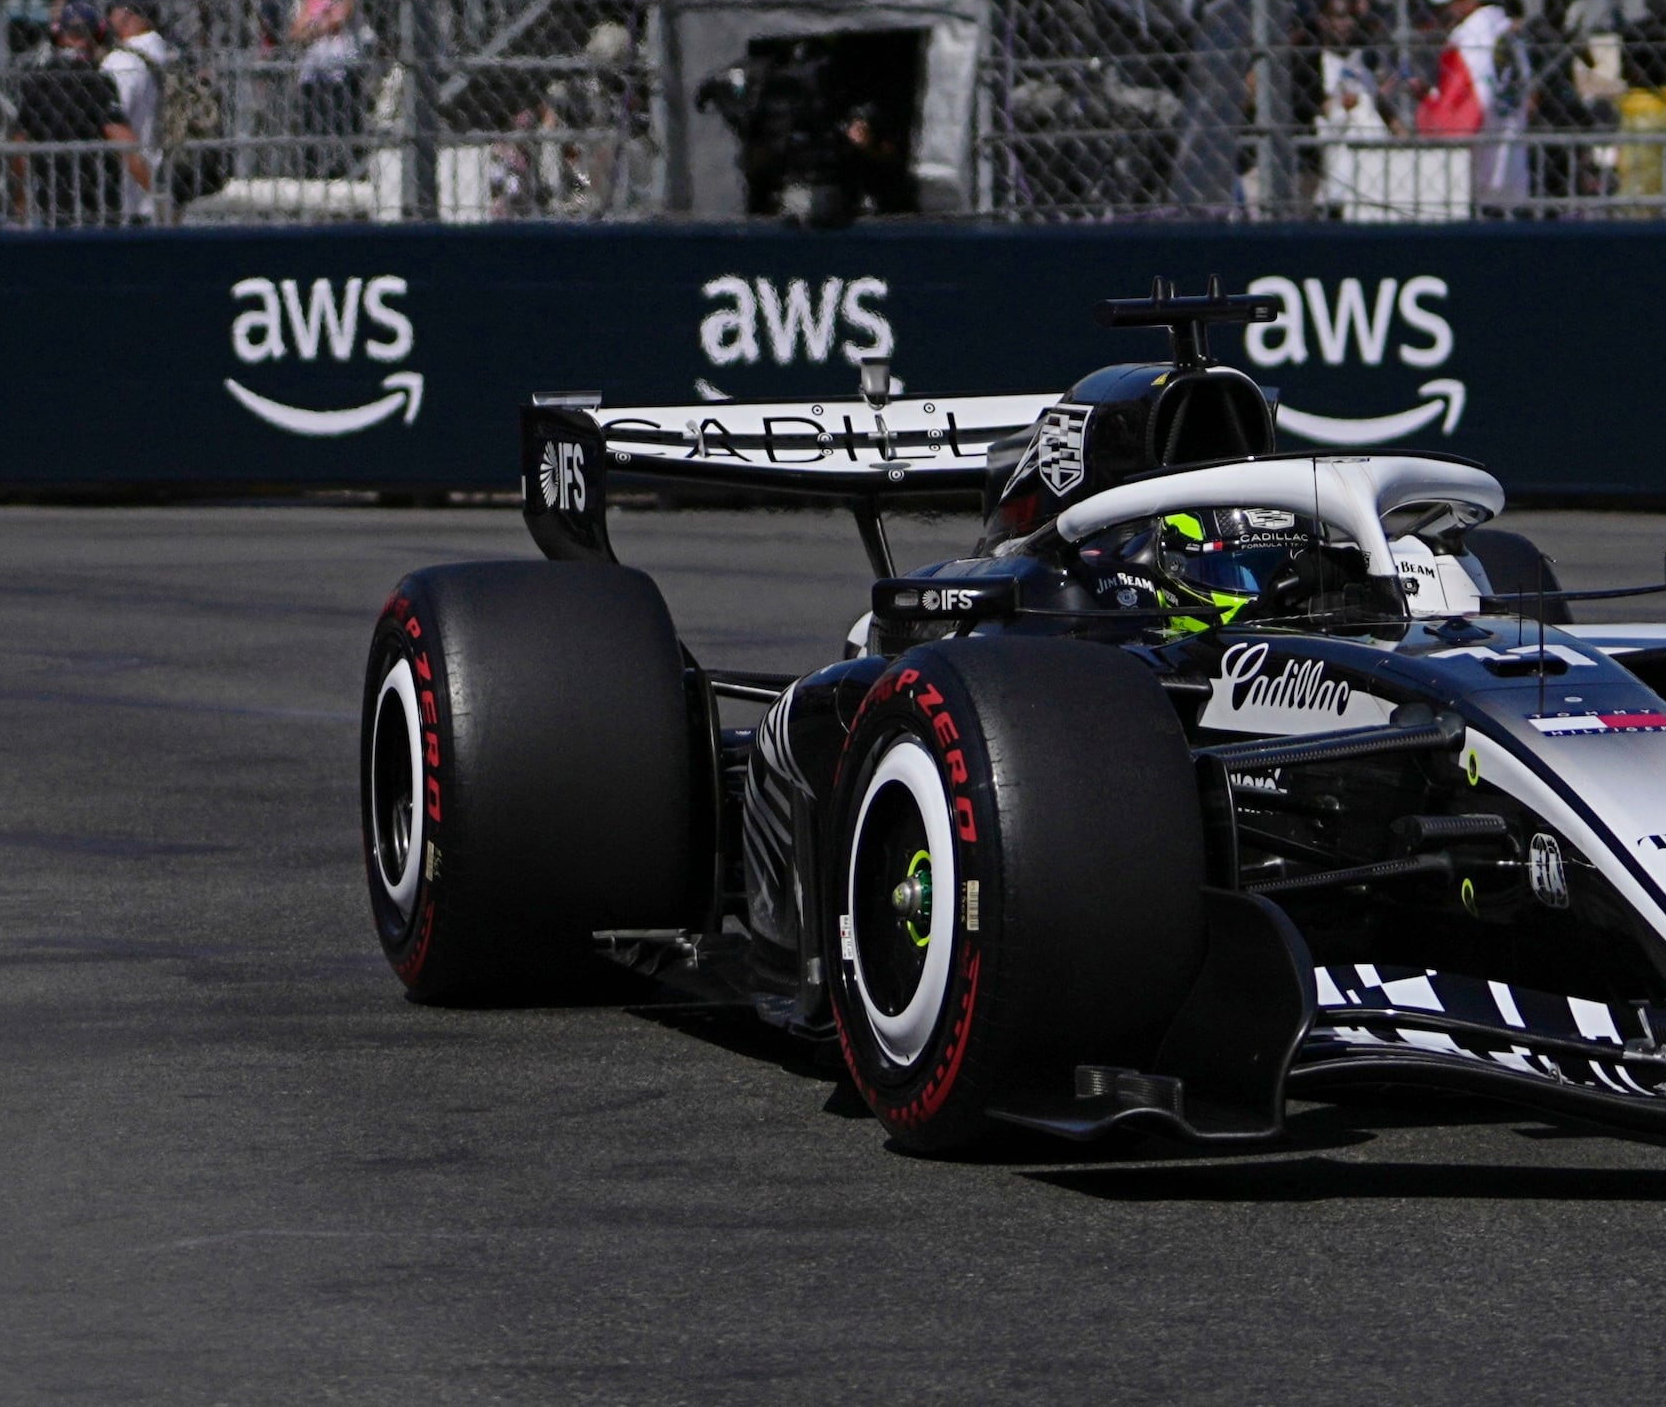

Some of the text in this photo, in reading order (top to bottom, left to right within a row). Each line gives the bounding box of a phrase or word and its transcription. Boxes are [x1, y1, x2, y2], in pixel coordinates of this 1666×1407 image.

[232, 275, 414, 362] aws
[699, 275, 894, 365] aws
[1243, 275, 1454, 368] aws
[605, 412, 988, 463] CADILL
[558, 442, 585, 513] IFS
[1240, 533, 1308, 543] CADILLAC
[1400, 561, 1435, 578] BEAM
[941, 589, 973, 610] IFS
[1097, 573, 1156, 594] JIM BEAM
[1221, 642, 1349, 716] Cadillac
[1532, 709, 1650, 719] TOMMY
[405, 616, 423, 639] P
[416, 651, 442, 823] ZERO
[895, 668, 920, 692] P
[917, 683, 978, 843] ZERO
